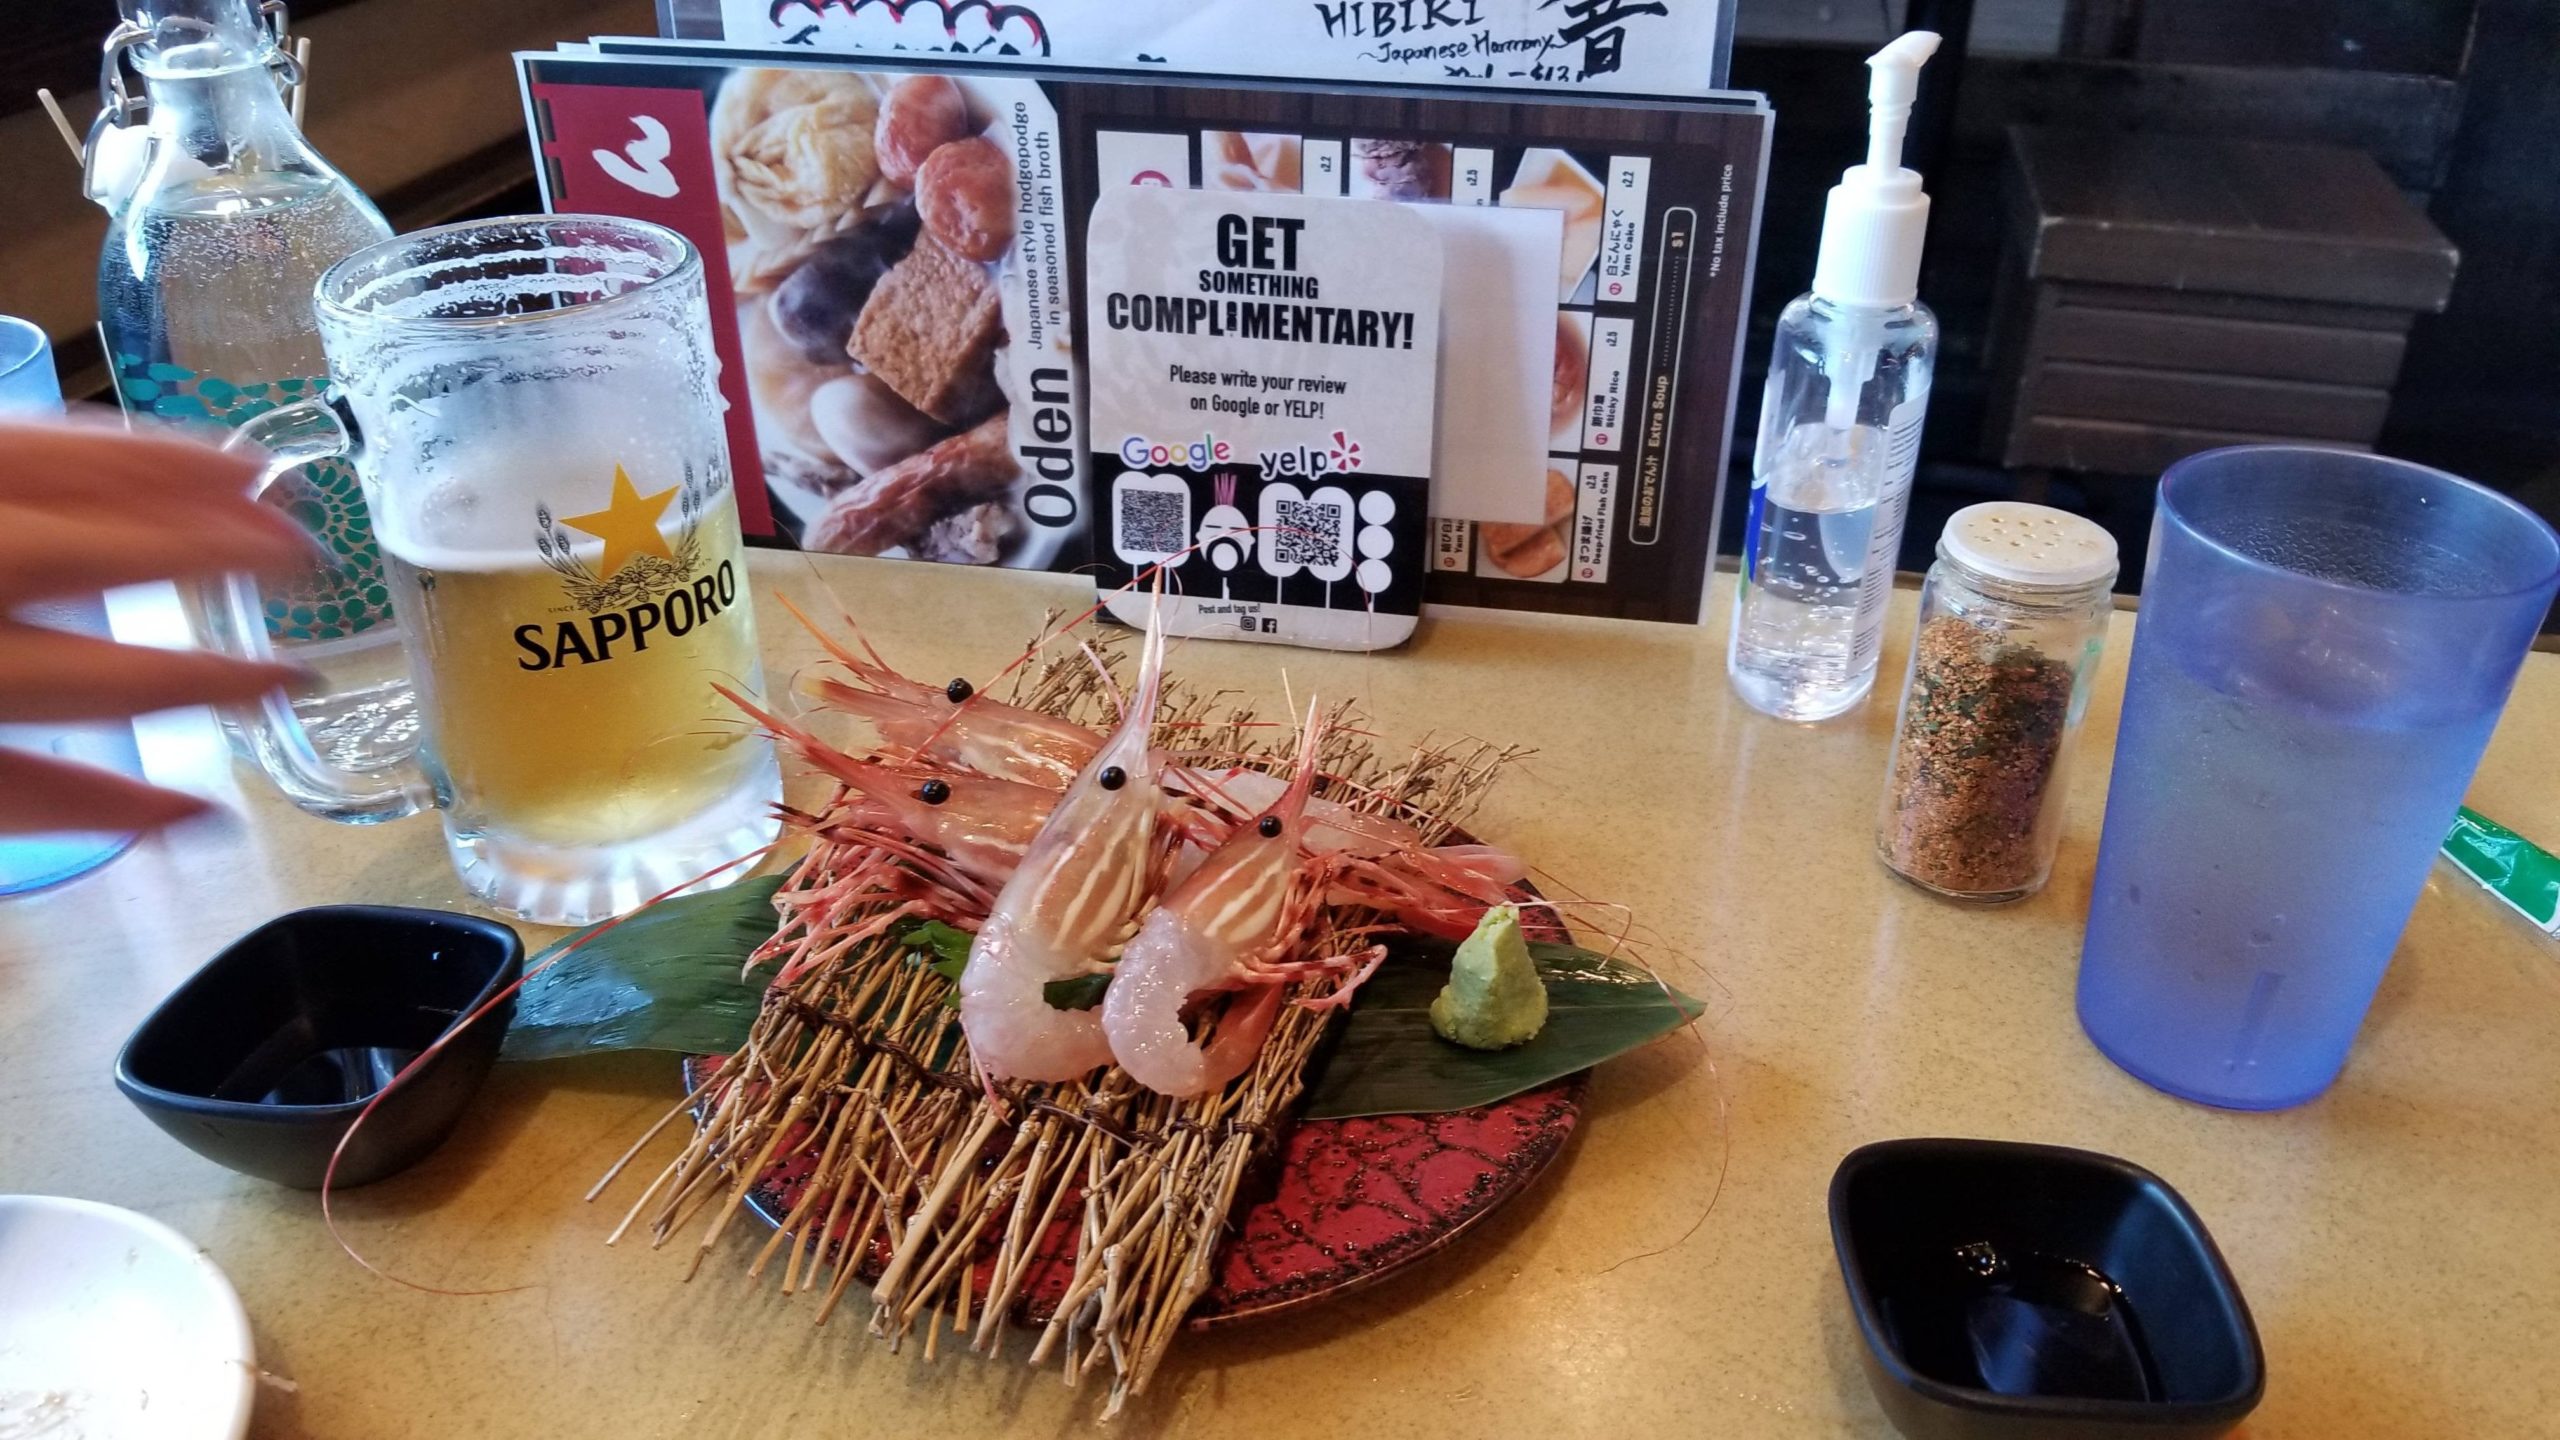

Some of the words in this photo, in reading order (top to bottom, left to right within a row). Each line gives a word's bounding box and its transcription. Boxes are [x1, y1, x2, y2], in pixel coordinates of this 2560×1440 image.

[1315, 0, 1486, 38] HIBIKI
[1012, 101, 1034, 214] hodgepodge
[1034, 131, 1053, 180] broth
[1722, 164, 1734, 192] price
[1038, 186, 1054, 216] fish
[1715, 195, 1729, 234] include
[1020, 219, 1038, 263] style
[1217, 213, 1305, 271] GET
[1624, 222, 1636, 250] Cake
[1712, 235, 1725, 255] tax
[1040, 222, 1060, 305] seasoned
[1620, 254, 1632, 277] Yam
[1199, 270, 1319, 299] SOMETHING
[1027, 269, 1044, 350] Japanese
[1046, 311, 1061, 326] in
[1106, 292, 1415, 350] COMPLIMENTARY!
[1169, 364, 1217, 385] Please
[1221, 370, 1258, 388] write
[1261, 375, 1294, 393] your
[1298, 375, 1347, 394] review
[1653, 375, 1669, 409] Soup
[1190, 397, 1207, 410] on
[1212, 394, 1260, 418] Google
[1264, 402, 1280, 416] or
[1283, 399, 1325, 419] YELP!
[1606, 397, 1619, 428] Sticky
[1648, 414, 1663, 447] Extra
[1020, 368, 1077, 528] Oden
[1122, 433, 1231, 469] Google
[1260, 446, 1327, 477] yelp
[1600, 471, 1610, 494] Cake
[1597, 497, 1608, 516] Fish
[1454, 535, 1463, 553] Yam
[513, 559, 735, 671] SAPPORO
[1198, 604, 1216, 614] Post
[1217, 603, 1232, 613] and
[1233, 604, 1247, 615] tag
